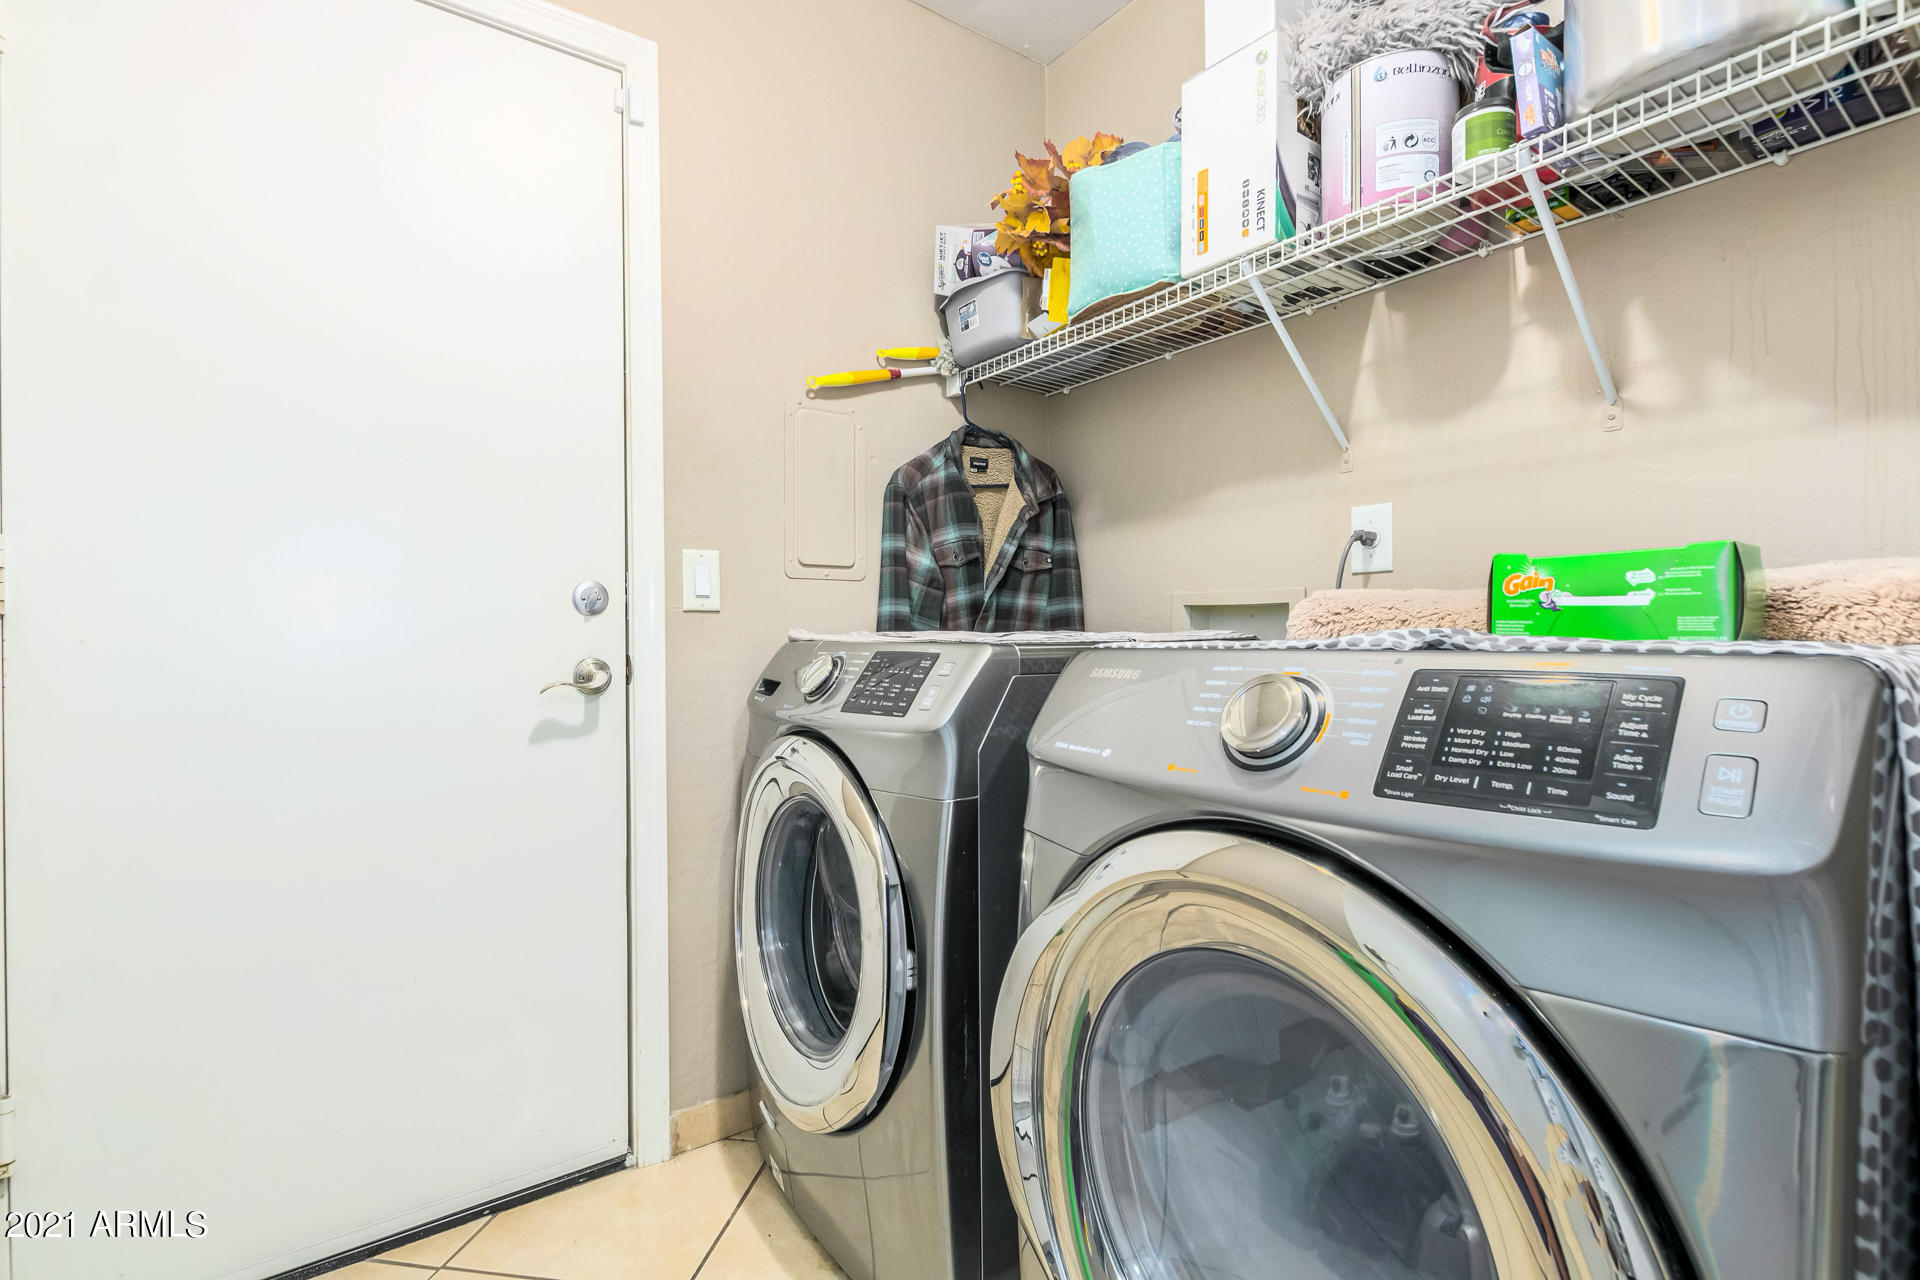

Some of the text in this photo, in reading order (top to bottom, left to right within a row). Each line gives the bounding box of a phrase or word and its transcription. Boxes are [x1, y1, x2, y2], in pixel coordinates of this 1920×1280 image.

[1392, 63, 1453, 79] Bellinzon
[1256, 188, 1266, 231] KINECT
[1503, 571, 1555, 596] Gain
[1089, 667, 1142, 680] SAMSUNG
[1622, 693, 1664, 703] My Cycle
[1619, 722, 1649, 731] Adjust
[1456, 728, 1486, 737] Very Dry
[1504, 731, 1522, 739] High
[1618, 729, 1640, 738] Time
[1471, 738, 1485, 746] Dry
[1502, 741, 1531, 749] Medium
[1451, 747, 1489, 756] Normal Dry
[1556, 746, 1582, 754] 60min
[1448, 756, 1482, 765] Damp Dry
[1554, 756, 1580, 765] 40min
[1613, 754, 1644, 764] Adjust
[1496, 761, 1533, 770] Extra Low
[1612, 761, 1635, 771] Time
[1552, 766, 1577, 775] 20min
[1434, 774, 1470, 784] Dry Level
[1491, 780, 1514, 790] Temp.
[1546, 787, 1569, 797] Time
[1605, 792, 1636, 802] Sound
[1620, 818, 1638, 826] Care
